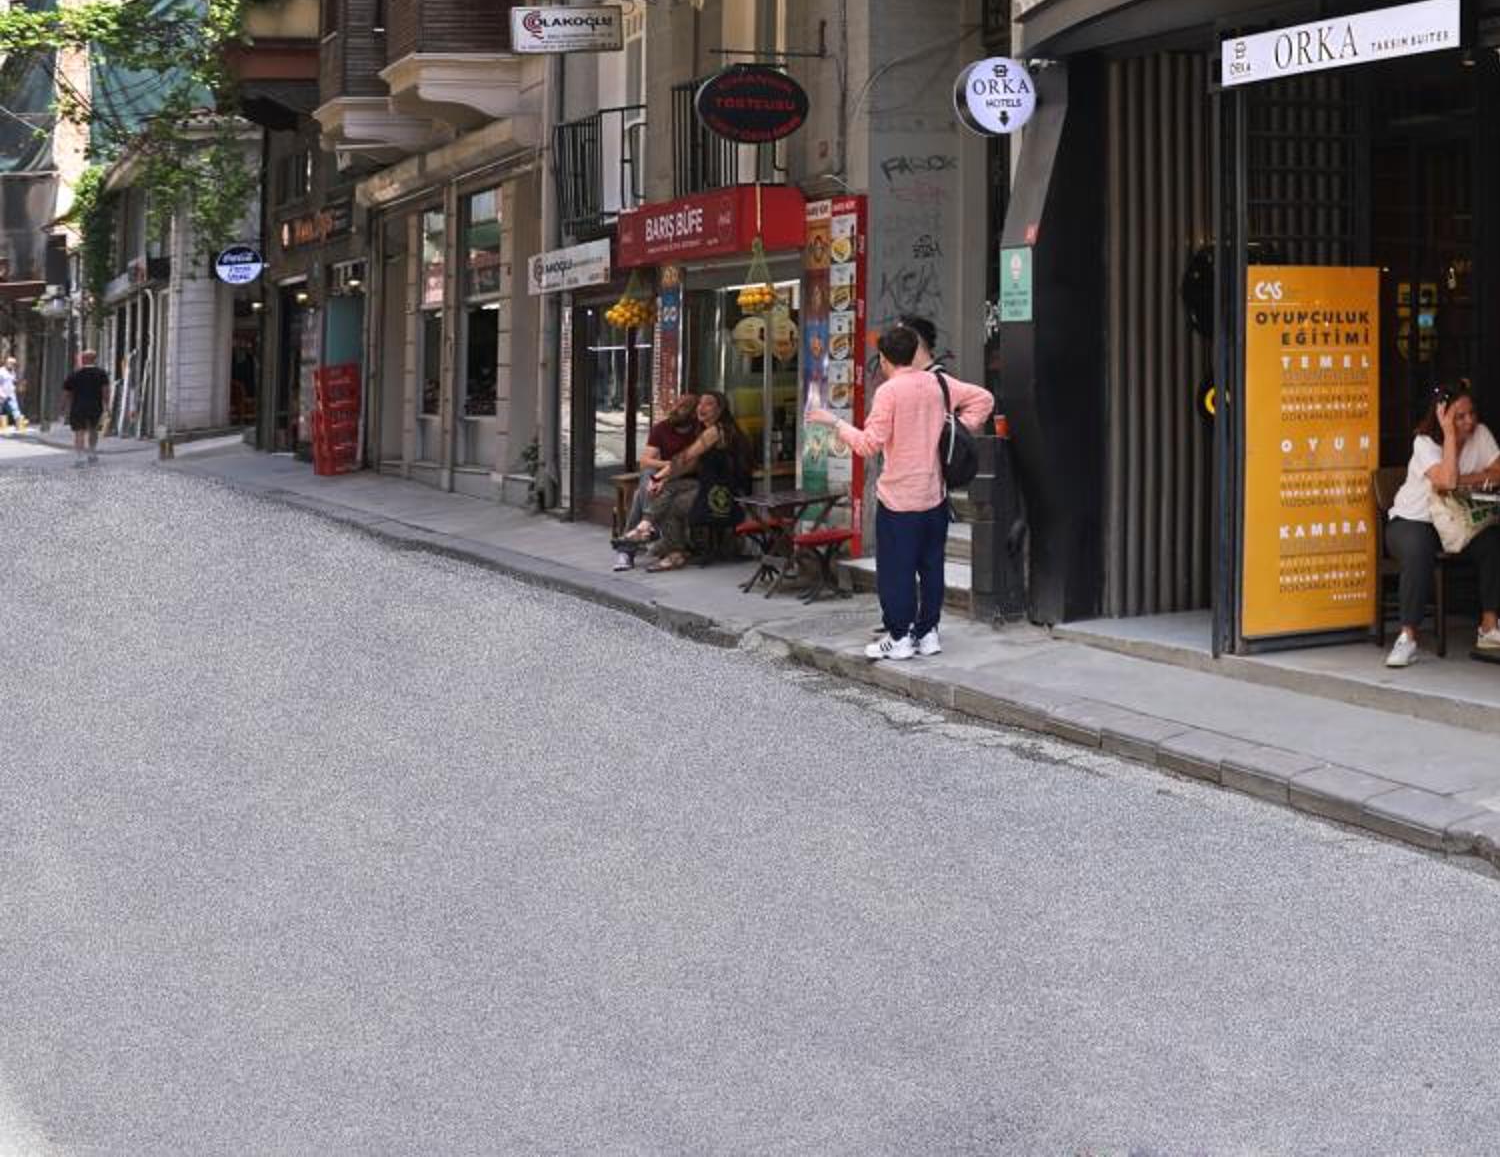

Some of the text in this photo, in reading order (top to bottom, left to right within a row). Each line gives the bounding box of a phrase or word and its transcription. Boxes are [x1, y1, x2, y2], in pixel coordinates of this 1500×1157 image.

[1274, 22, 1449, 70] ORKA TAKSIM SUITES
[973, 78, 1030, 96] ORKA
[985, 98, 1022, 108] HOTELS
[645, 211, 675, 242] BARIŞ
[675, 204, 704, 236] BÜFE
[1255, 280, 1283, 300] CAS
[1255, 310, 1370, 325] OYUNCULUK
[1281, 328, 1370, 346] EĞİTİMİ
[1281, 354, 1370, 369] TEMEL
[1280, 435, 1369, 453] OYUN
[1279, 520, 1368, 540] KAMERA
